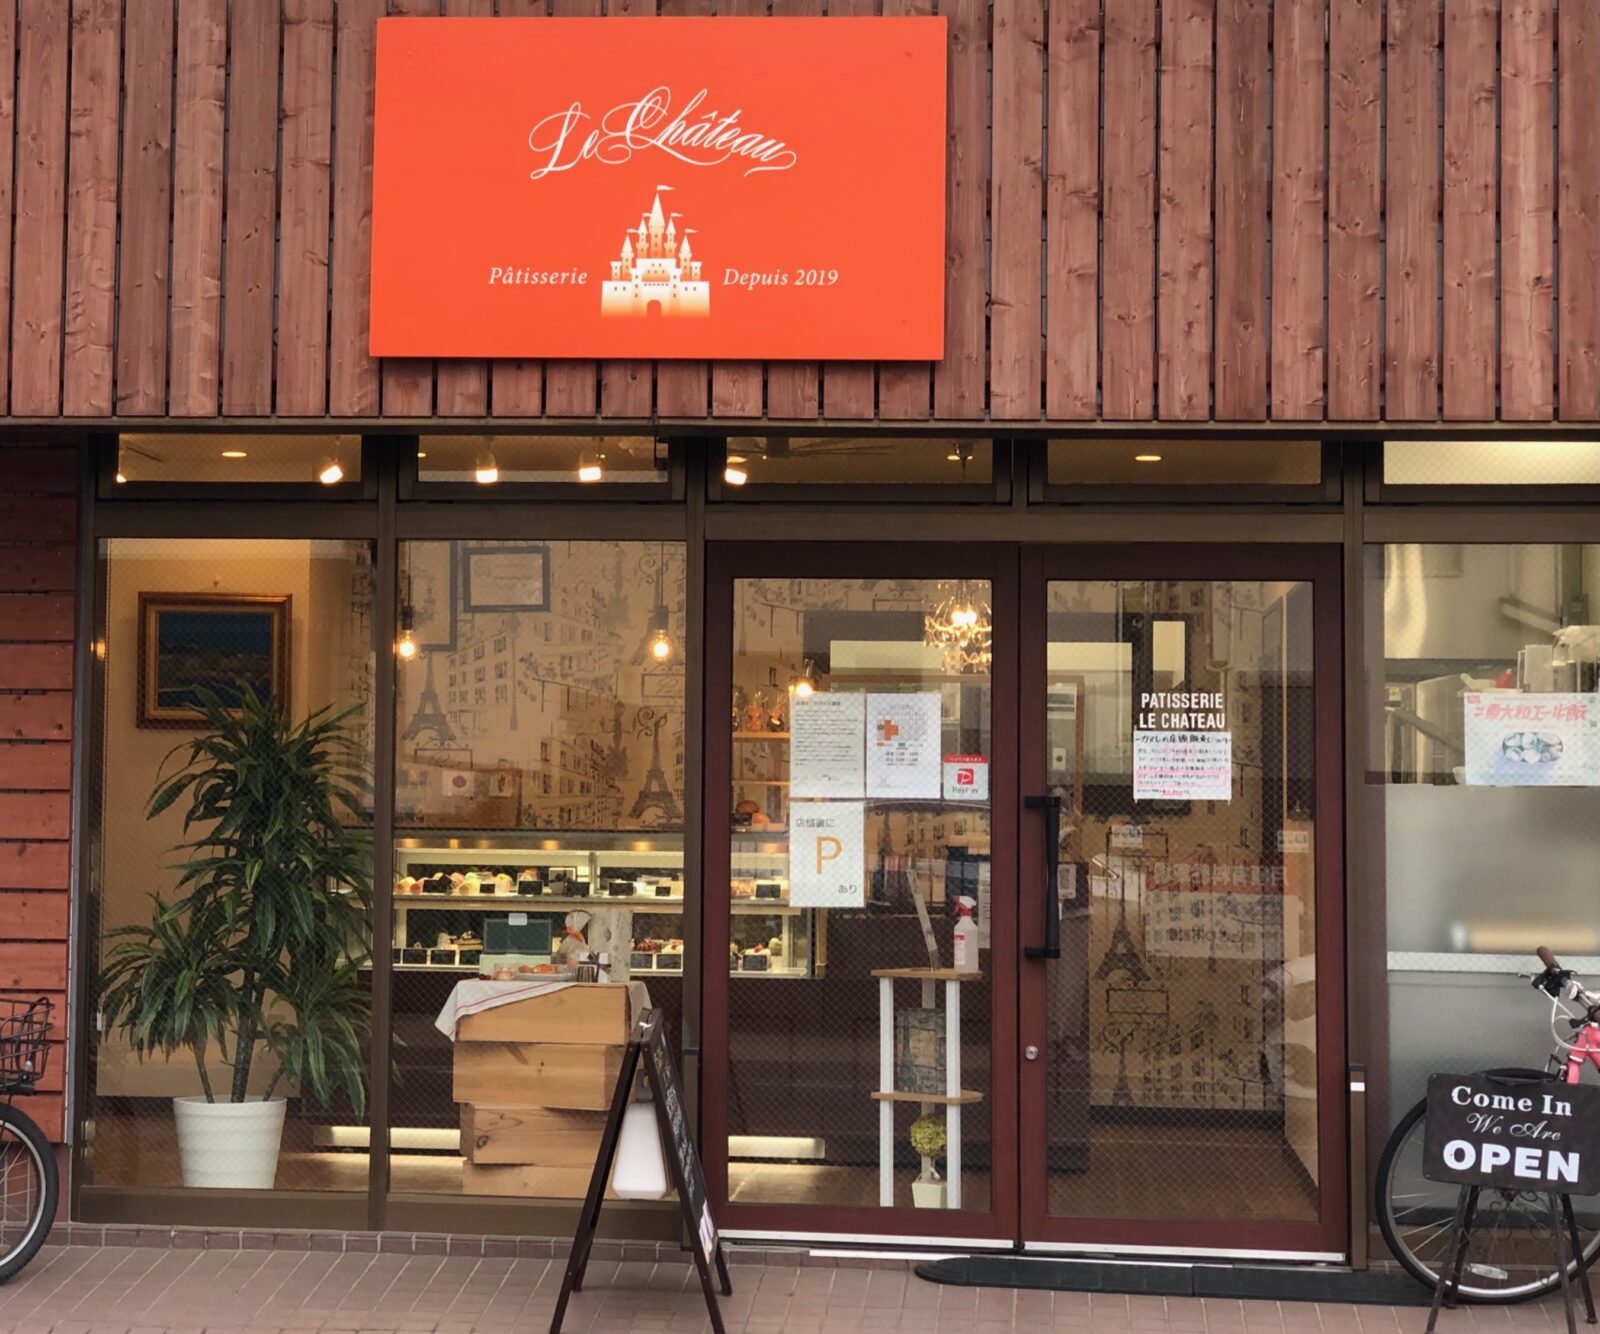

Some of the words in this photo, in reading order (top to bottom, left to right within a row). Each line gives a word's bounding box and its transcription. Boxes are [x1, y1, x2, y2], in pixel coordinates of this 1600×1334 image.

[529, 102, 600, 179] Le
[597, 86, 797, 177] Château
[489, 267, 587, 285] Pâtisserie
[723, 269, 788, 290] Depuis
[794, 269, 838, 286] 2019
[1141, 693, 1223, 709] PATISSERIE
[1139, 713, 1156, 729] LE
[1161, 713, 1225, 729] CHATEAU
[952, 786, 979, 795] PayPay
[816, 835, 842, 875] P
[838, 884, 857, 894] あり
[1451, 1085, 1533, 1111] Come
[1541, 1094, 1572, 1116] In
[1466, 1112, 1504, 1133] We
[1510, 1121, 1561, 1141] Are
[1443, 1139, 1580, 1183] OPEN
